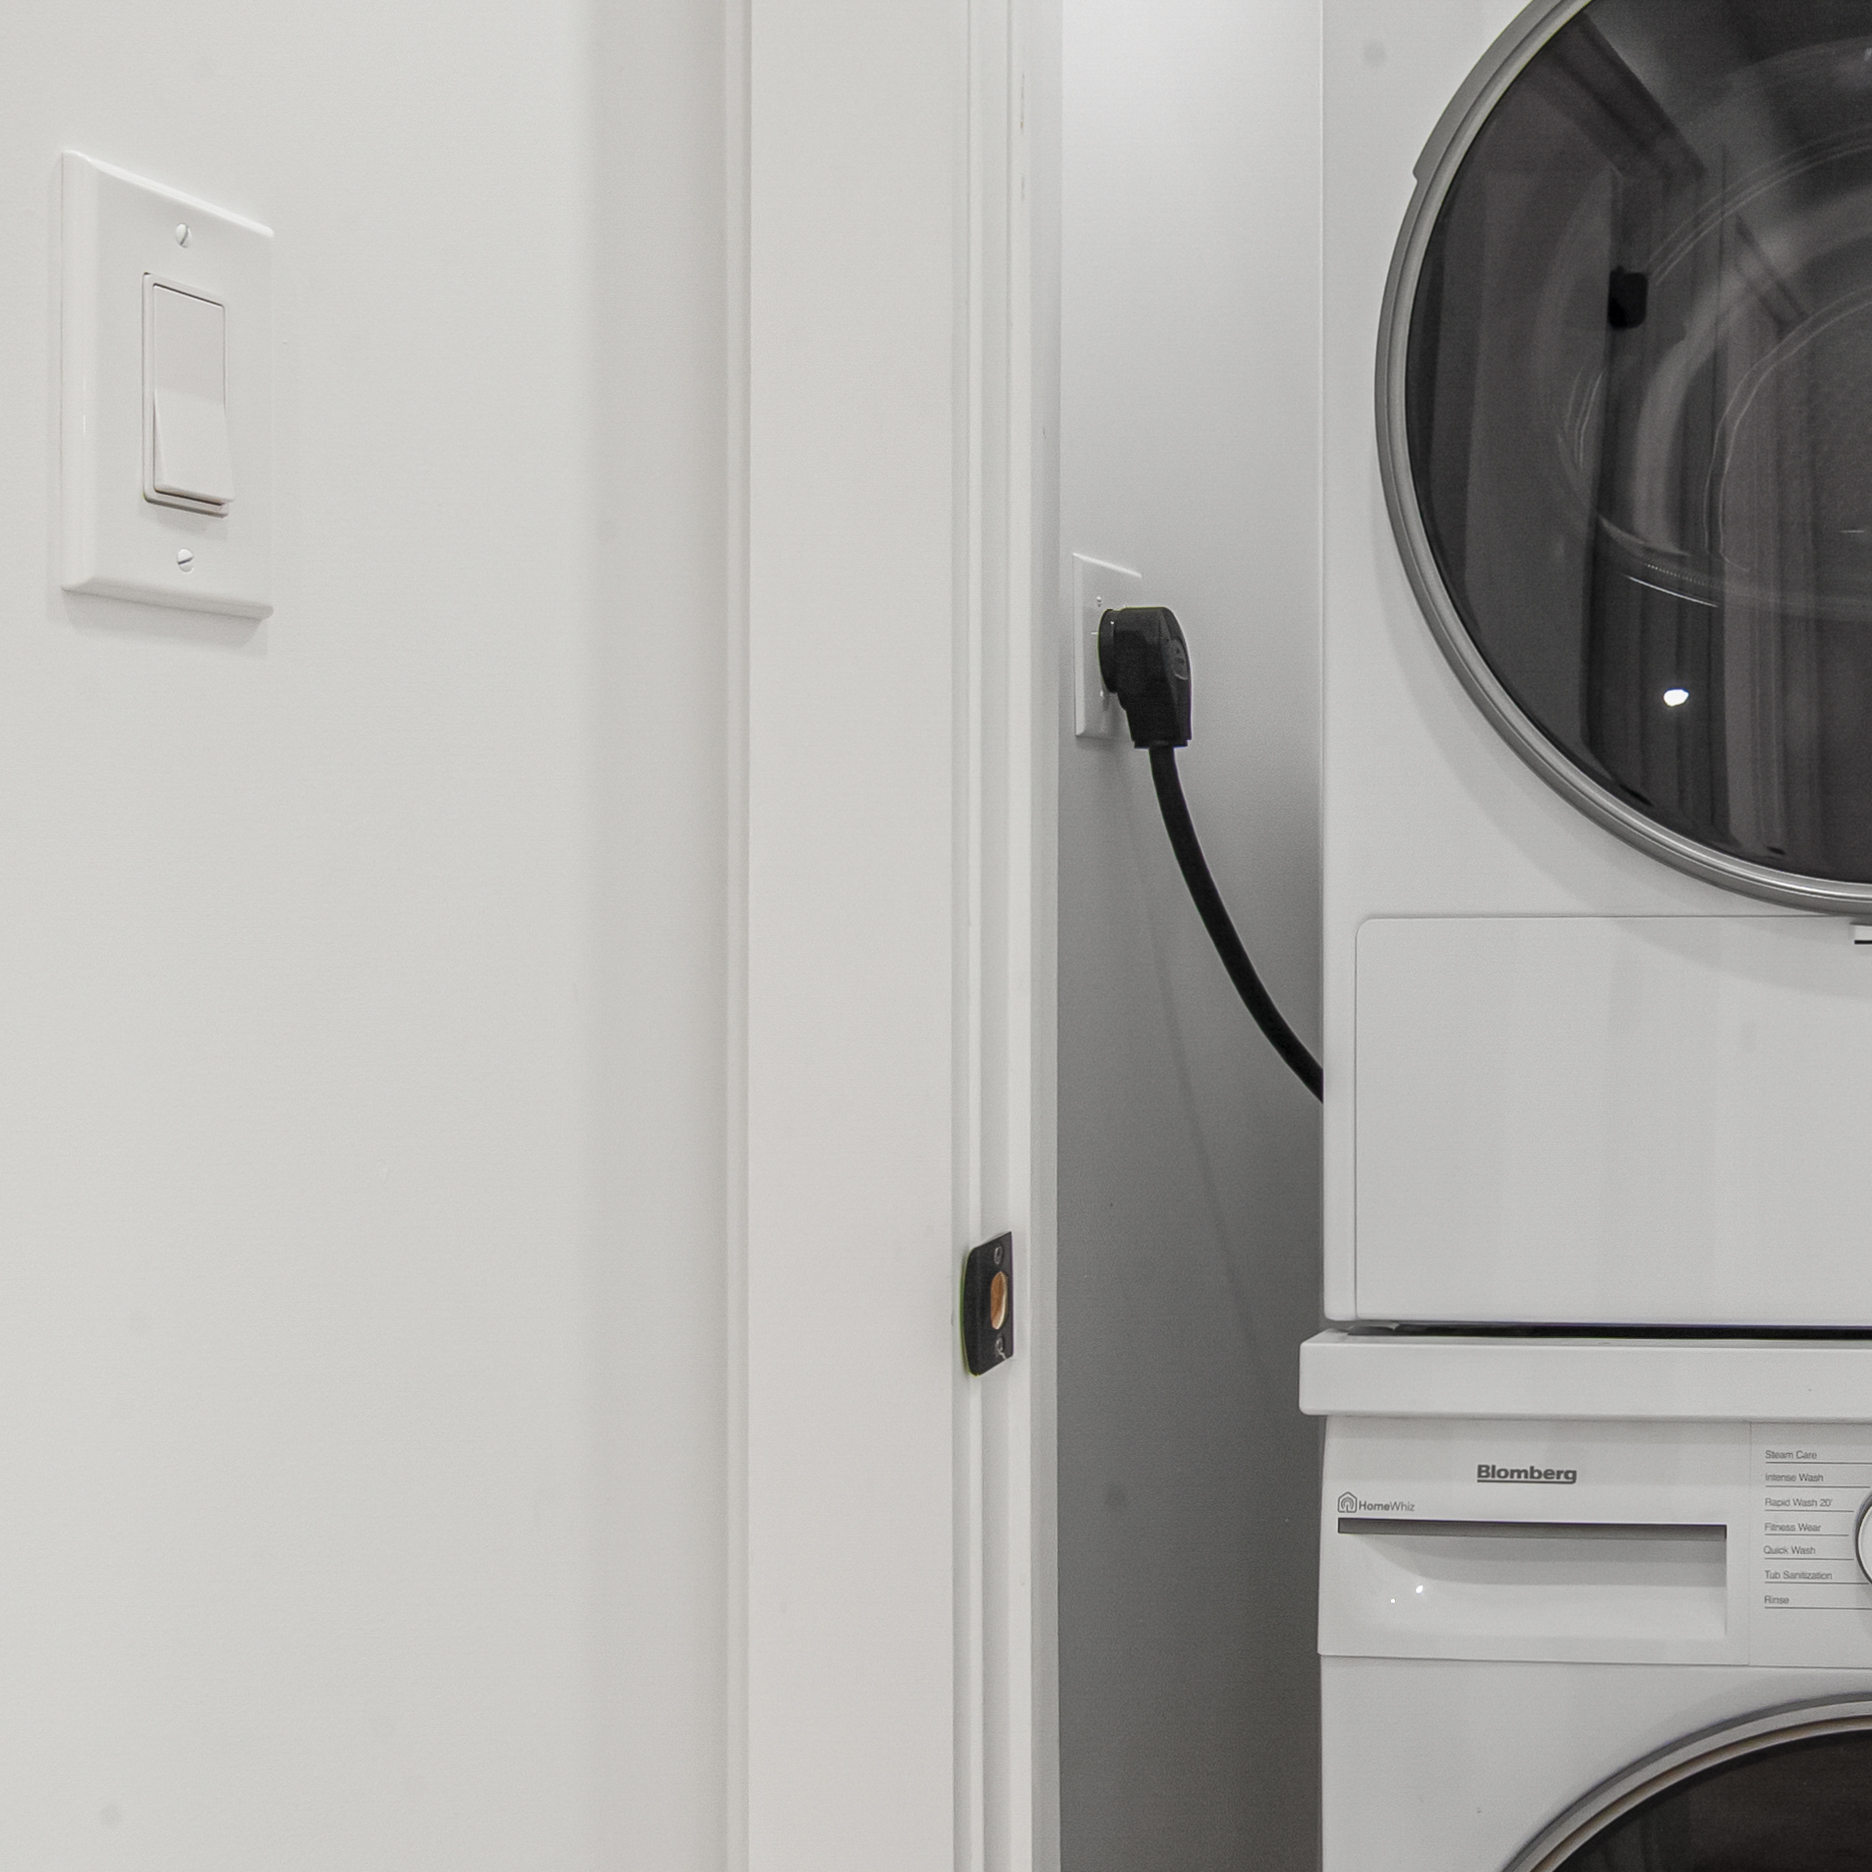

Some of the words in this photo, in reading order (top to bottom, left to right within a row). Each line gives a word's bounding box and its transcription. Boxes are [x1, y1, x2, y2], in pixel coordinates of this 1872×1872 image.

[1765, 1449, 1794, 1460] Steam
[1795, 1450, 1817, 1460] Care
[1477, 1464, 1577, 1482] Blomberg
[1765, 1473, 1797, 1482] Intense
[1799, 1473, 1824, 1482] Wash
[1358, 1499, 1415, 1512] HomeWhiz
[1764, 1498, 1791, 1508] Rapid
[1792, 1498, 1818, 1507] Wash
[1764, 1522, 1796, 1532] Fitness
[1797, 1523, 1821, 1532] Wear
[1763, 1545, 1789, 1555] Quick
[1791, 1546, 1816, 1555] Wash
[1764, 1570, 1781, 1579] Tub
[1783, 1570, 1833, 1580] Sanitization
[1764, 1595, 1790, 1604] Rinse
